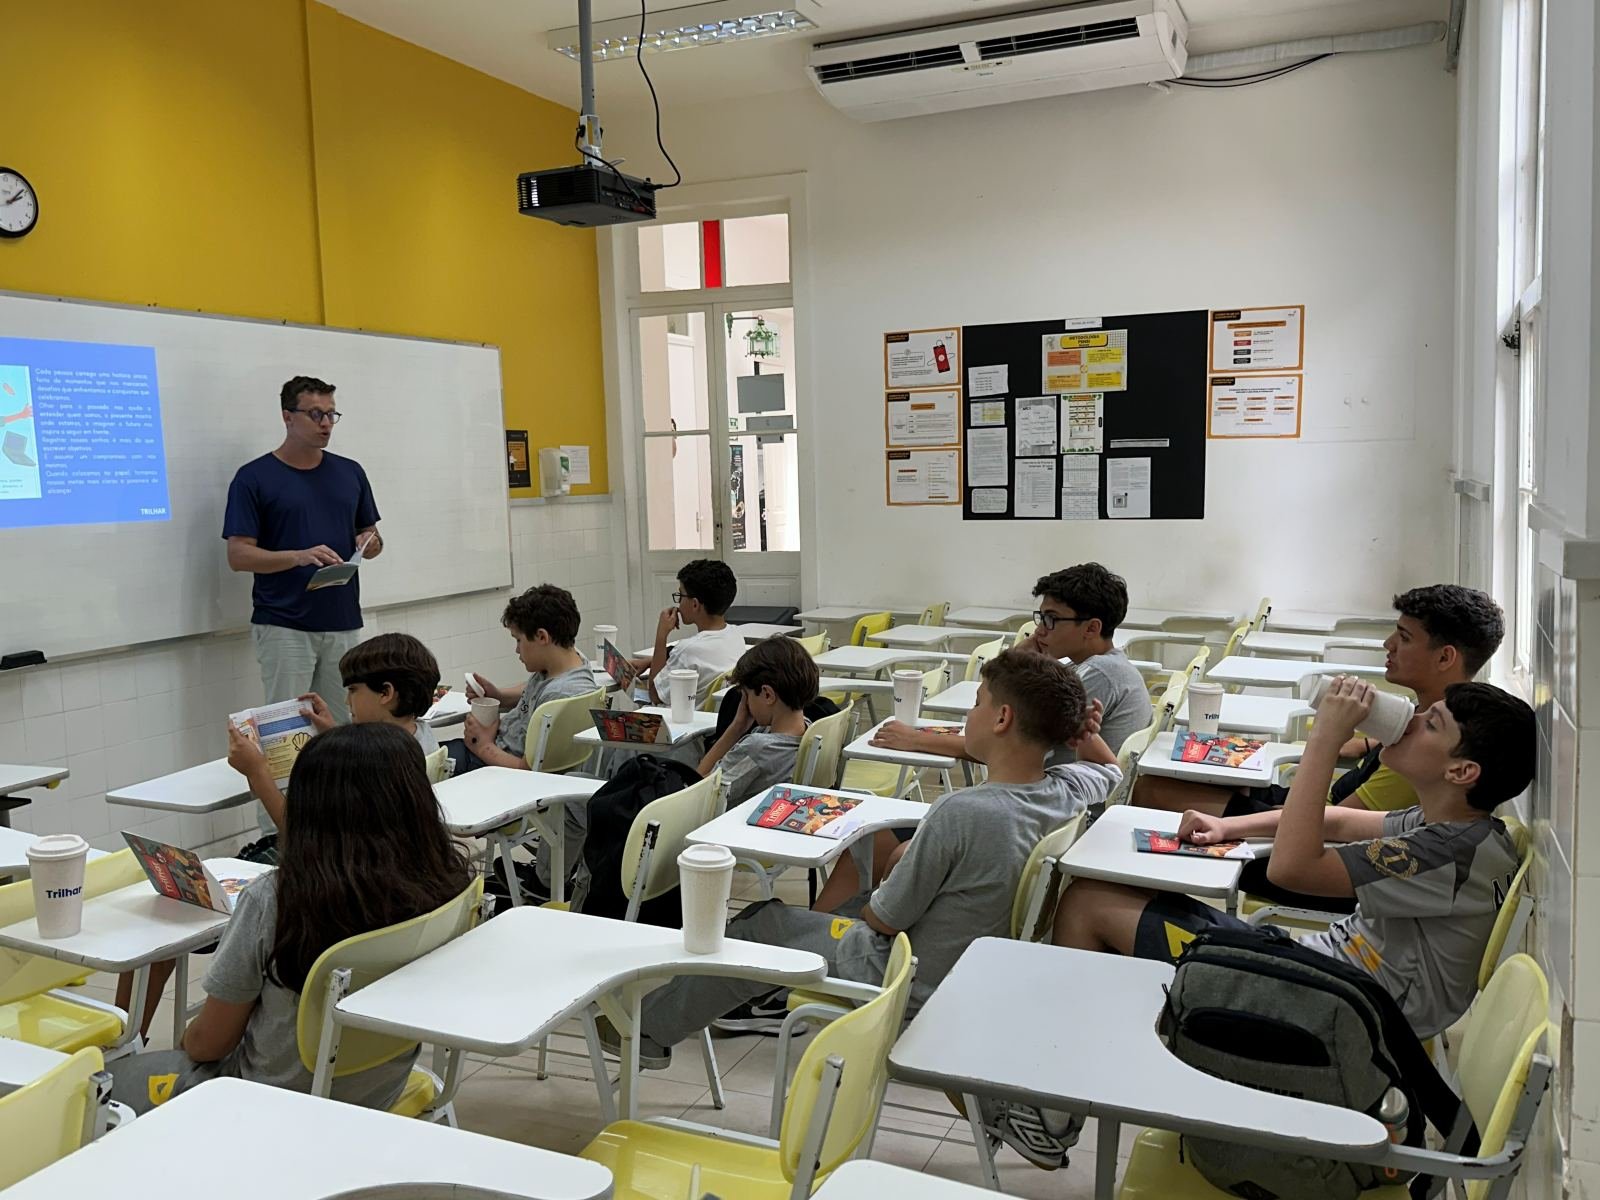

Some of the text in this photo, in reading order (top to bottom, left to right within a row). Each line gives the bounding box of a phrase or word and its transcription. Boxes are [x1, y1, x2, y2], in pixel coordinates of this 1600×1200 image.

[140, 507, 166, 516] TRILHAR
[766, 802, 788, 823] Trilhar
[45, 886, 82, 899] Trilhar
